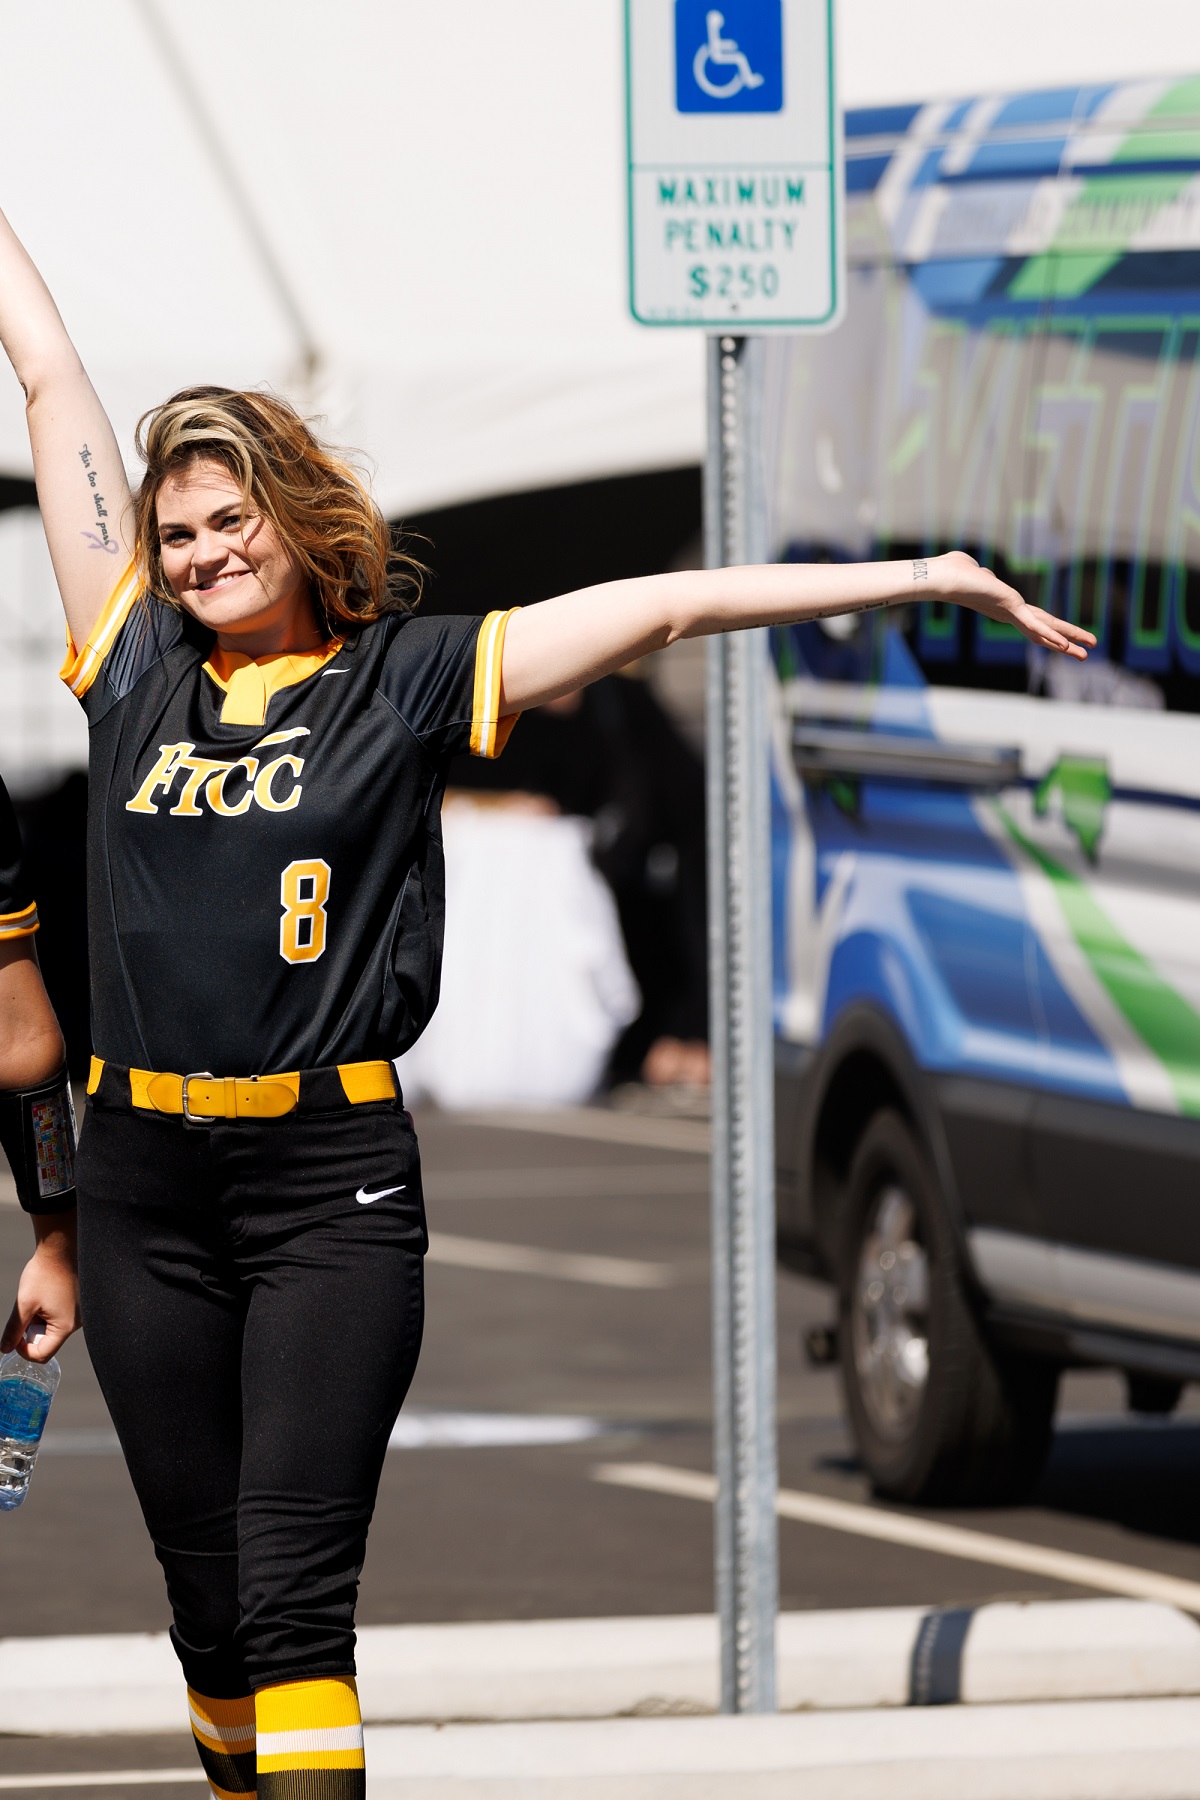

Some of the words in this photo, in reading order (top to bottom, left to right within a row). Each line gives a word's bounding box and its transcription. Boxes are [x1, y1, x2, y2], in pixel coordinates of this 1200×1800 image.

[658, 178, 806, 207] MAXIMUM
[665, 217, 797, 251] PENALTY
[688, 263, 780, 299] $250
[78, 444, 92, 468] This
[87, 471, 98, 488] too
[93, 493, 108, 517] shall
[95, 522, 110, 546] pass
[125, 727, 311, 816] FTCC
[279, 858, 332, 965] 8
